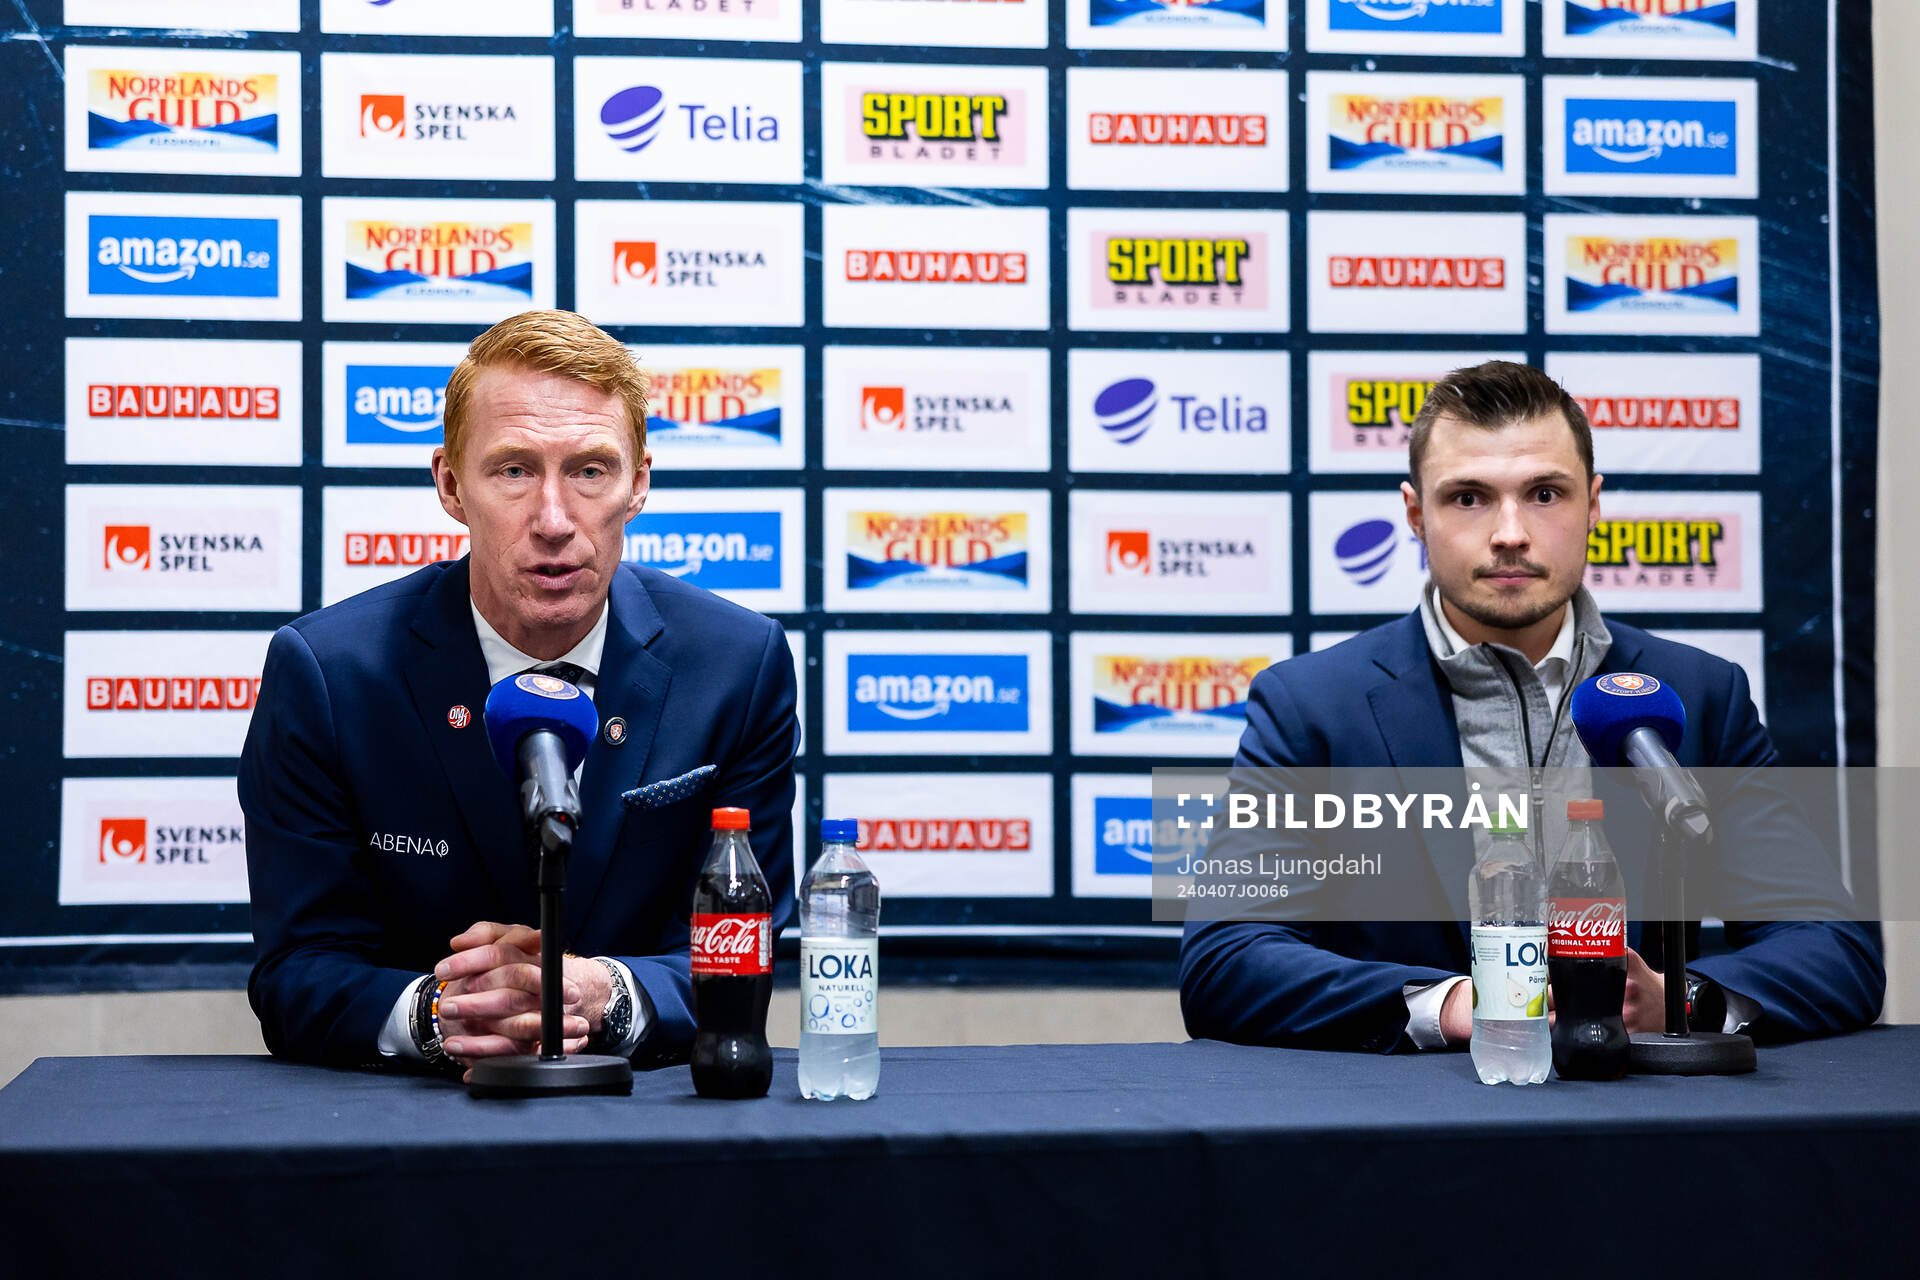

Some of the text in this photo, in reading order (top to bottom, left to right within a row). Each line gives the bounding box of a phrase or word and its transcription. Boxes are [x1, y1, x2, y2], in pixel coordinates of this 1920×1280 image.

[108, 75, 259, 104] NORRLANDS
[128, 97, 241, 129] GULD
[415, 103, 516, 121] SVENSKA
[678, 105, 779, 142] Telia
[863, 92, 1008, 143] SPORT
[1347, 98, 1486, 125] NORRLANDS
[415, 124, 468, 141] SPEL
[1090, 113, 1266, 146] BAUHAUS
[1366, 121, 1470, 150] GULD
[1572, 118, 1729, 150] amazon.se
[870, 145, 1002, 160] BLADET
[366, 226, 514, 252] NORRLANDS
[97, 237, 271, 269] amazon.se
[385, 248, 496, 280] GULD
[666, 250, 767, 267] SVENSKA
[1108, 237, 1249, 287] SPORT
[1584, 241, 1720, 268] NORRLANDS
[666, 270, 717, 287] SPEL
[847, 250, 1026, 284] BAUHAUS
[1329, 256, 1504, 288] BAUHAUS
[1602, 263, 1705, 292] GULD
[1115, 289, 1244, 304] BLADET
[89, 384, 279, 419] BAUHAUS
[914, 396, 1013, 412] SVENSKA
[1170, 396, 1268, 432] Telia
[1348, 381, 1432, 428] SPO
[1577, 397, 1739, 429] AUHAUS
[914, 416, 965, 432] SPEL
[159, 534, 263, 551] SVENSKA
[866, 516, 1010, 543] NORRLANDS
[885, 539, 993, 568] GULD
[1159, 541, 1255, 557] SVENSKA
[1587, 520, 1722, 568] SPORT
[159, 555, 214, 572] SPEL
[1159, 561, 1208, 577] SPEL
[1592, 572, 1717, 586] BLADET
[1112, 661, 1252, 688] NORRLANDS
[87, 677, 261, 711] BAUHAU
[856, 674, 1020, 704] amazon.se
[1132, 684, 1236, 711] GULD
[155, 826, 244, 843] SVENSK
[370, 832, 434, 856] ABENA
[155, 848, 210, 864] SPEL
[714, 956, 740, 964] TASTE
[810, 954, 873, 979] LOKA
[1506, 942, 1547, 967] LOK
